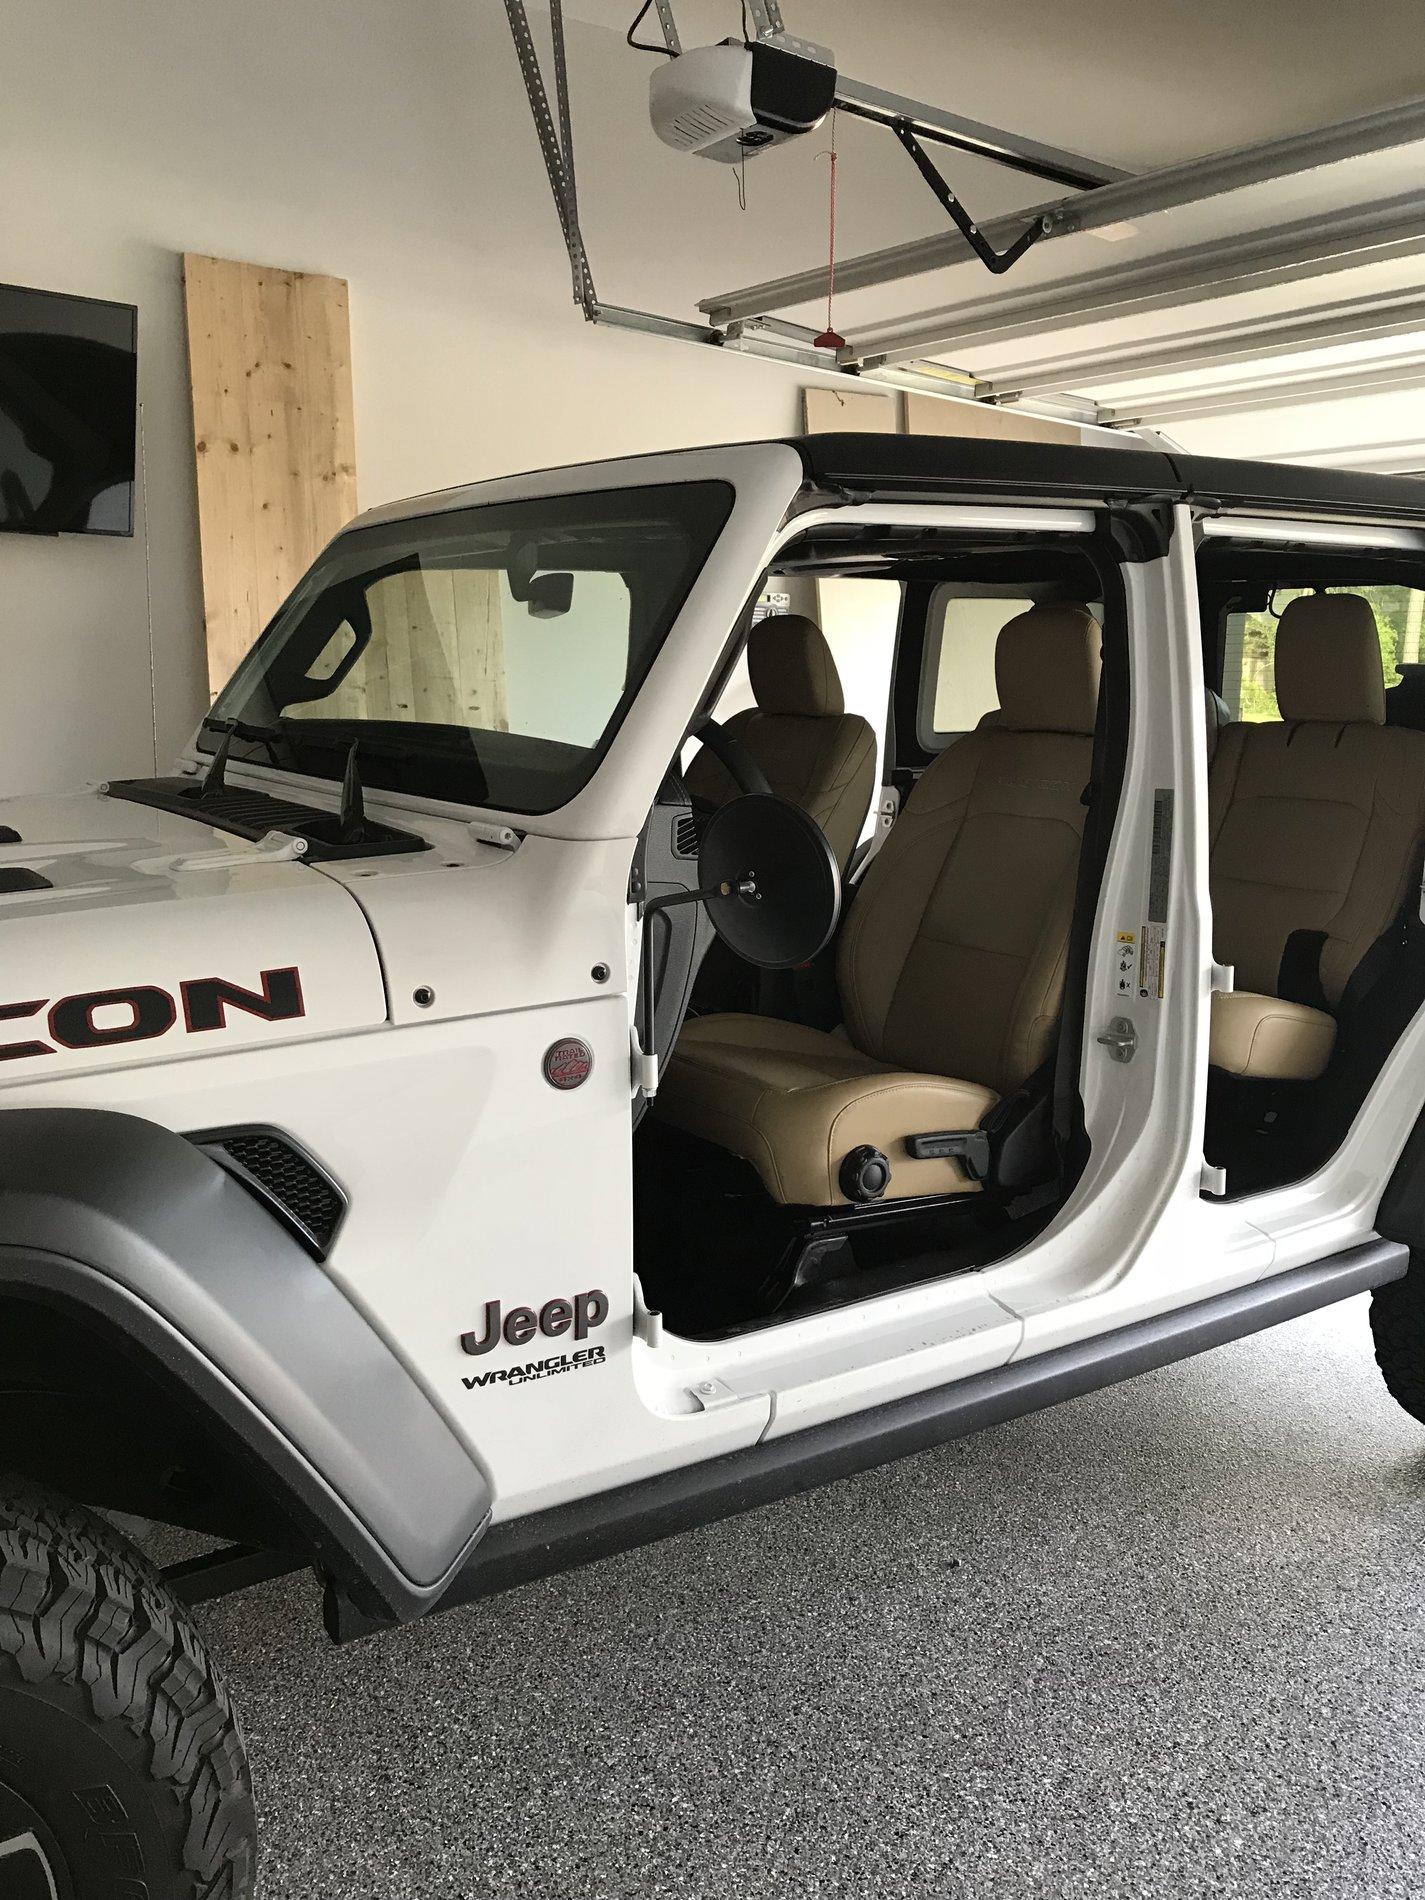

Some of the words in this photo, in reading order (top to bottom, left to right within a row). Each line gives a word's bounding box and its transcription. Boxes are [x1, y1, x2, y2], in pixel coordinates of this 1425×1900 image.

[460, 1289, 609, 1356] Jeep
[461, 1345, 606, 1390] WRANGLER
[508, 1356, 606, 1386] UNLIMITED
